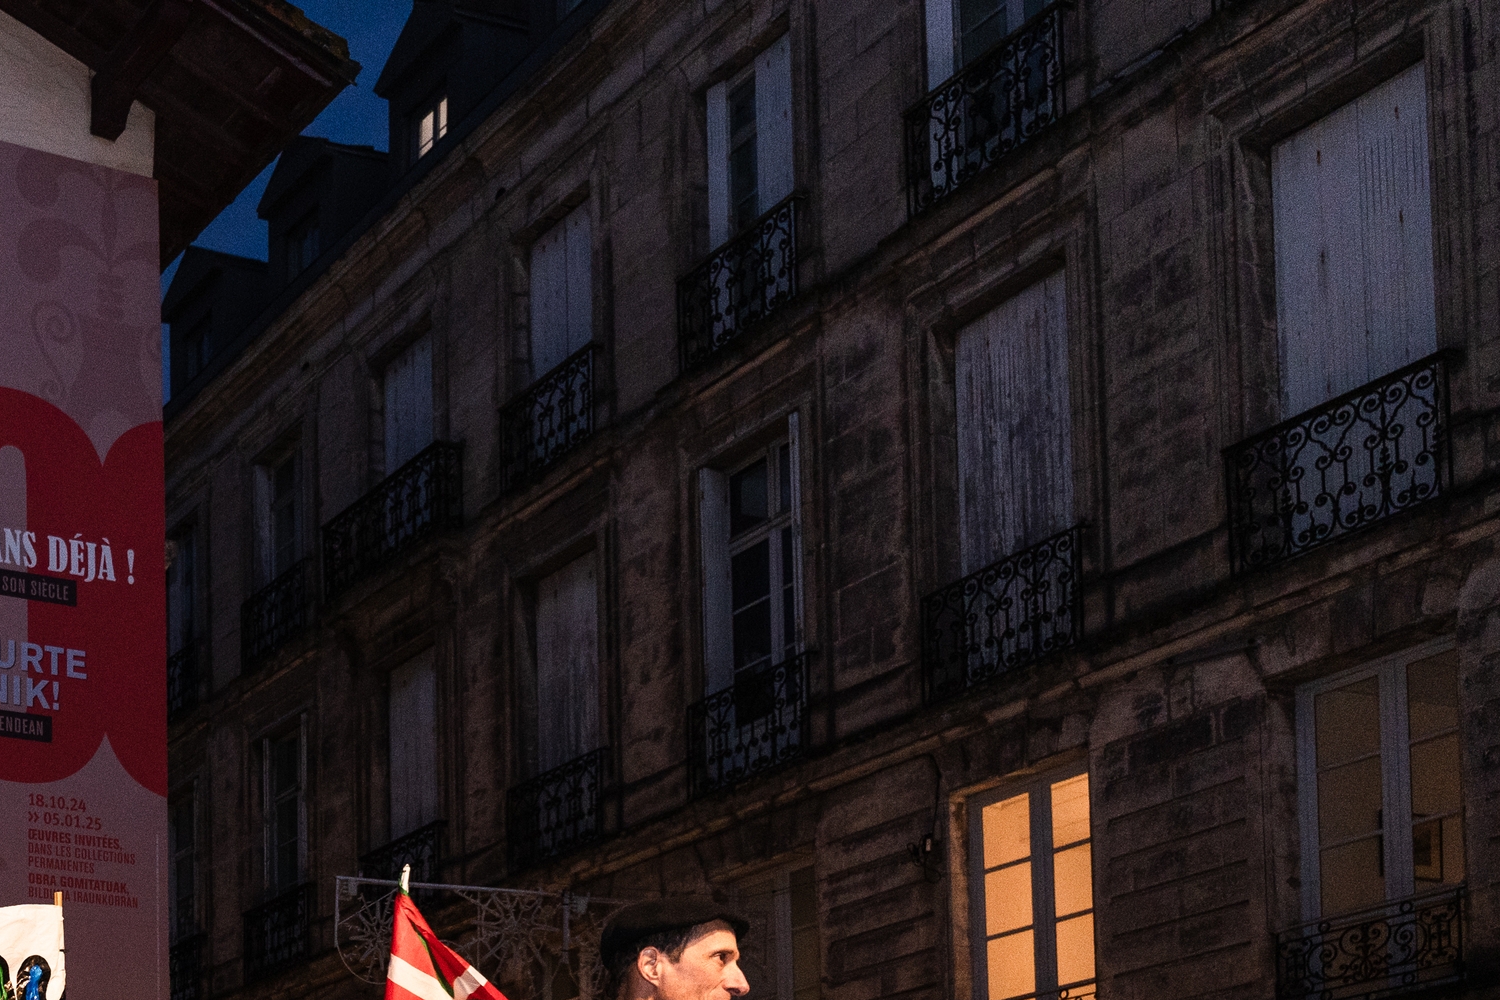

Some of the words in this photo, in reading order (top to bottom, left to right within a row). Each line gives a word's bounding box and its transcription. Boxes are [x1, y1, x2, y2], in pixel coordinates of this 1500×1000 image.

[46, 533, 117, 583] DÉJÀ
[2, 576, 27, 595] SON
[30, 579, 70, 601] SIÈCLE
[28, 793, 87, 813] 18.10.24
[43, 811, 102, 831] 05.01.25
[27, 828, 72, 844] ŒUVRES
[27, 841, 53, 857] DANS
[55, 845, 72, 858] LES
[74, 847, 136, 866] COLLECTIONS
[27, 855, 96, 875] PERMANENTES
[28, 872, 57, 887] OBRA
[27, 886, 71, 902] BILDUA
[73, 891, 139, 909] IRAUNKORRAN
